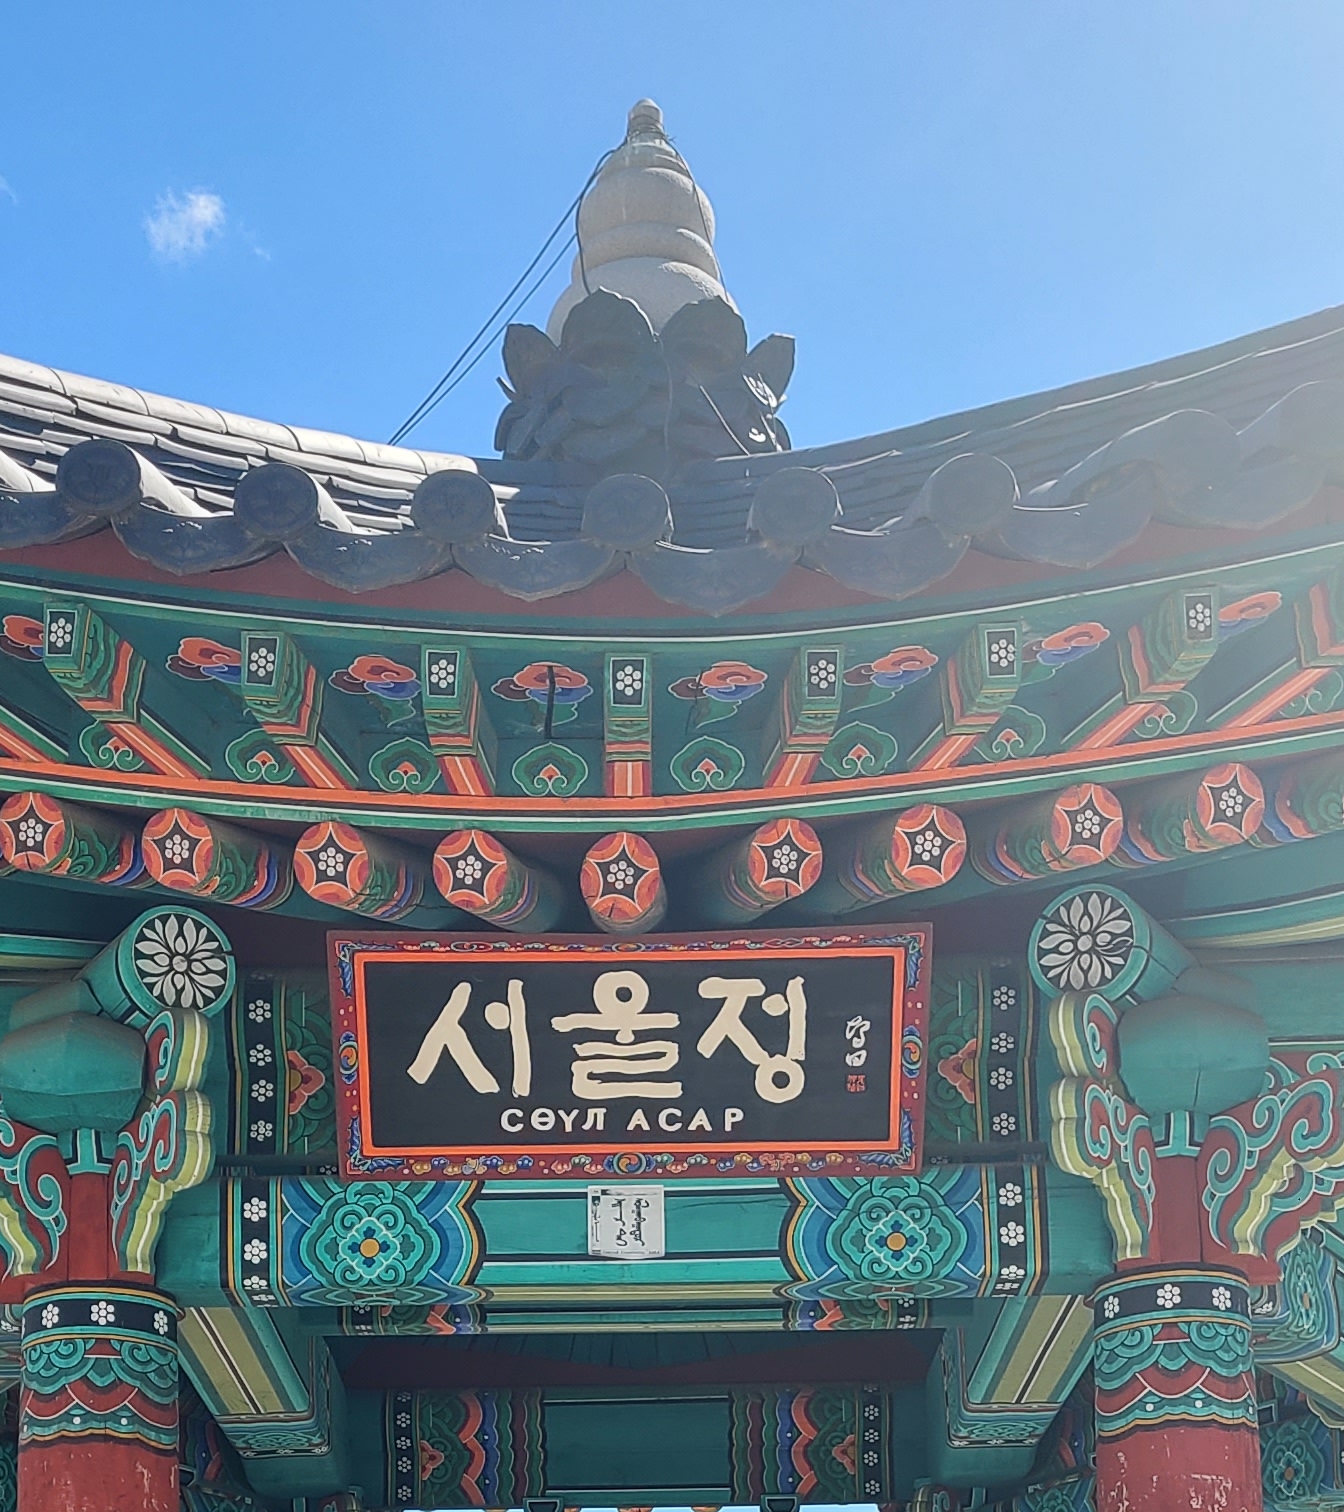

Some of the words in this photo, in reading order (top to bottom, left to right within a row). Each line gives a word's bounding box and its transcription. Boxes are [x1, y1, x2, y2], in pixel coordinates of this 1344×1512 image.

[407, 970, 807, 1104] 서울정
[500, 1107, 608, 1133] СӨҮЛ
[626, 1107, 746, 1133] АСАР
